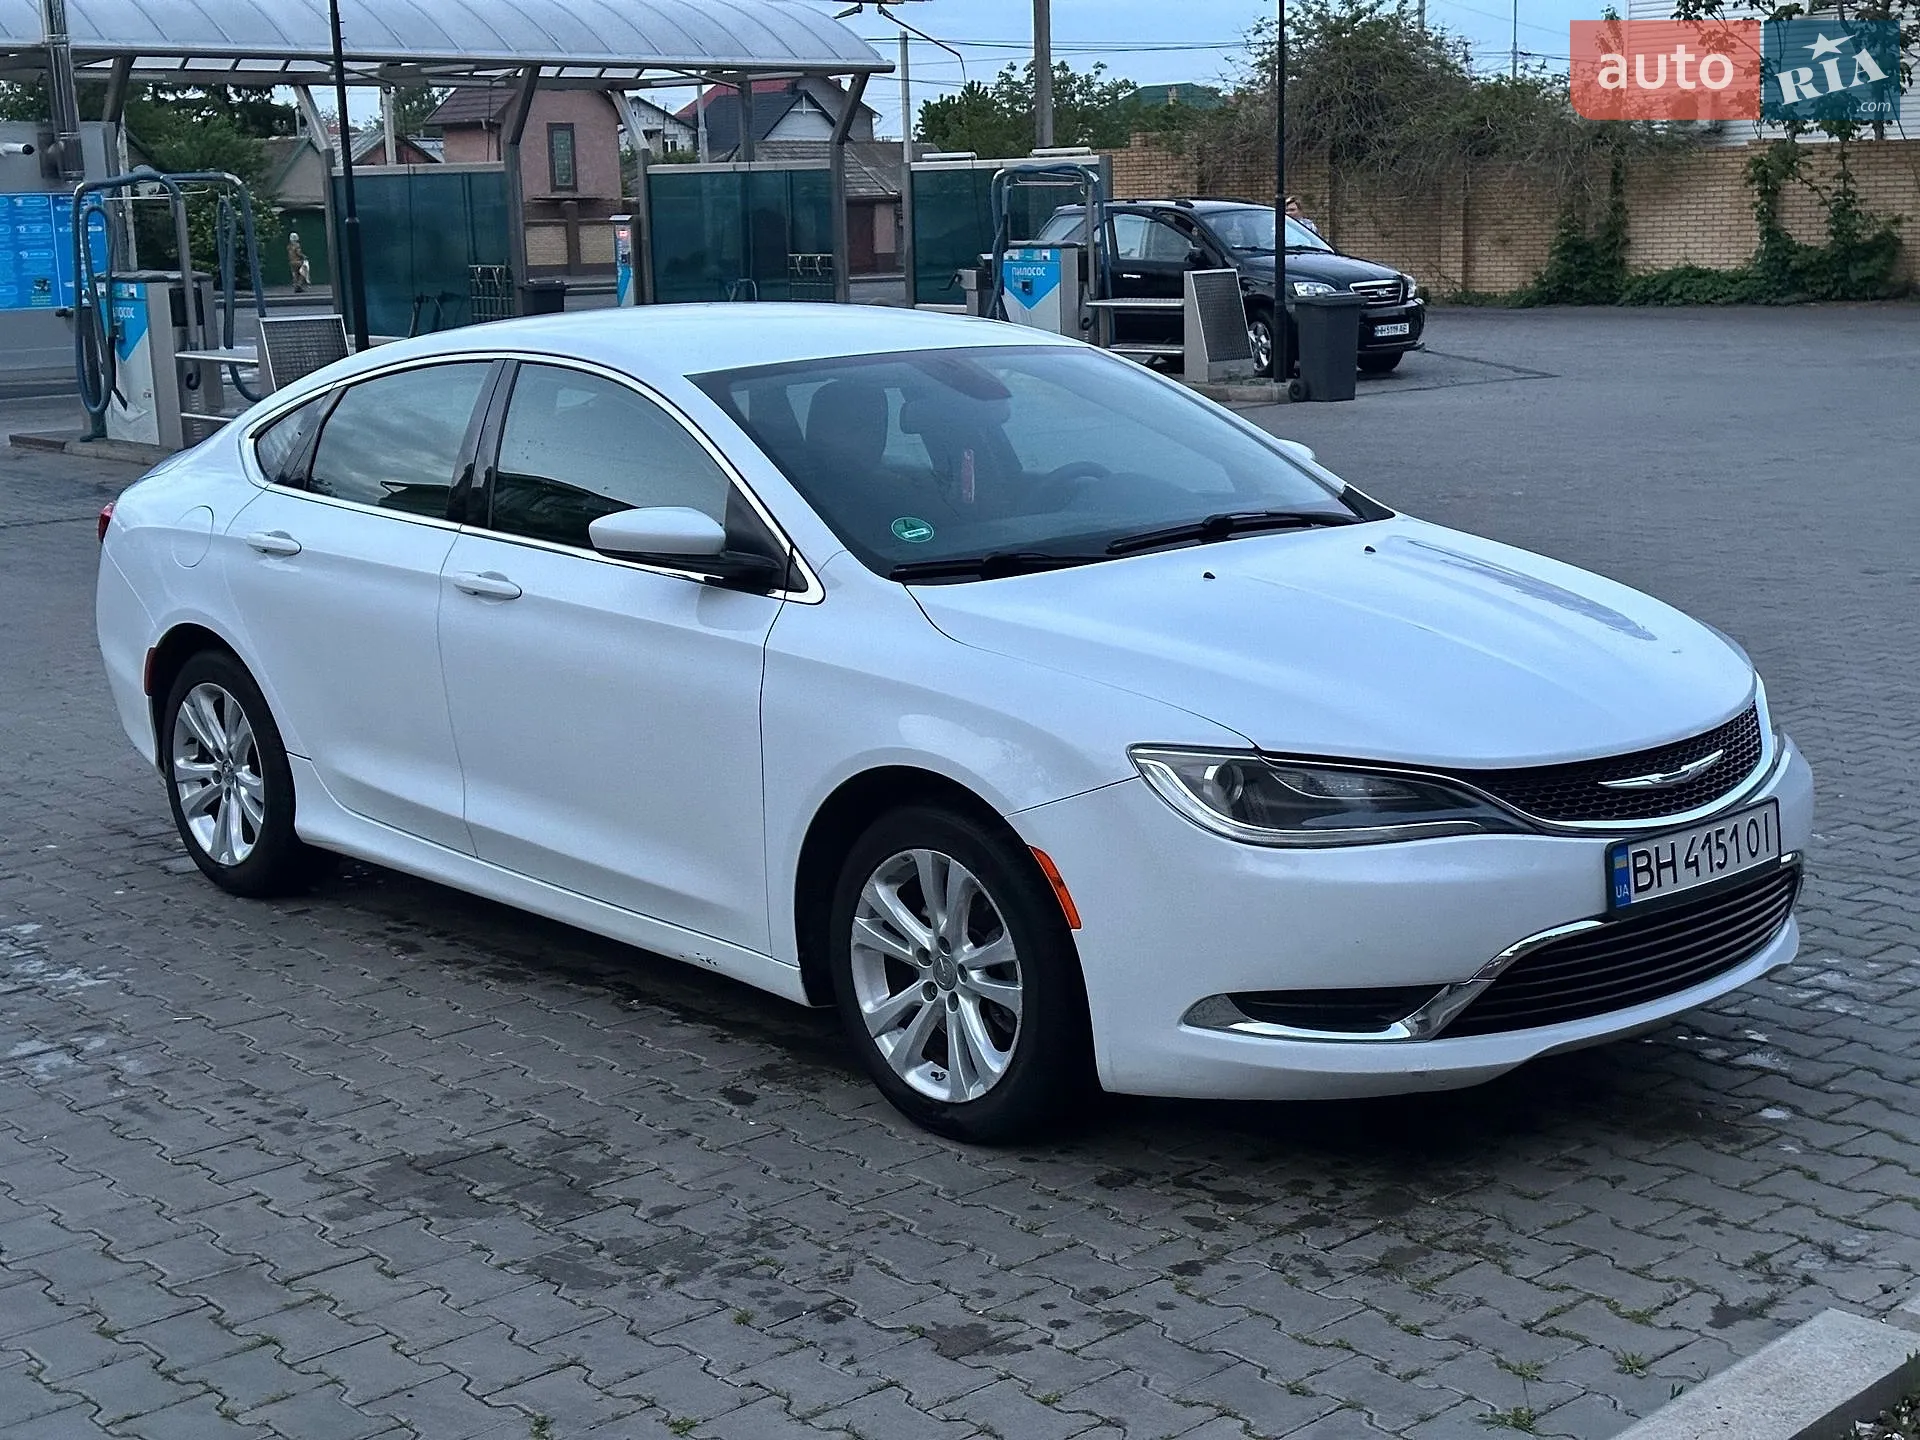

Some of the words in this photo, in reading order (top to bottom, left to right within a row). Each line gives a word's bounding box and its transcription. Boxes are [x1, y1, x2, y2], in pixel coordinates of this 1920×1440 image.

[1631, 841, 1678, 894] BH
[1684, 823, 1741, 878] 4151
[1615, 885, 1630, 899] UA
